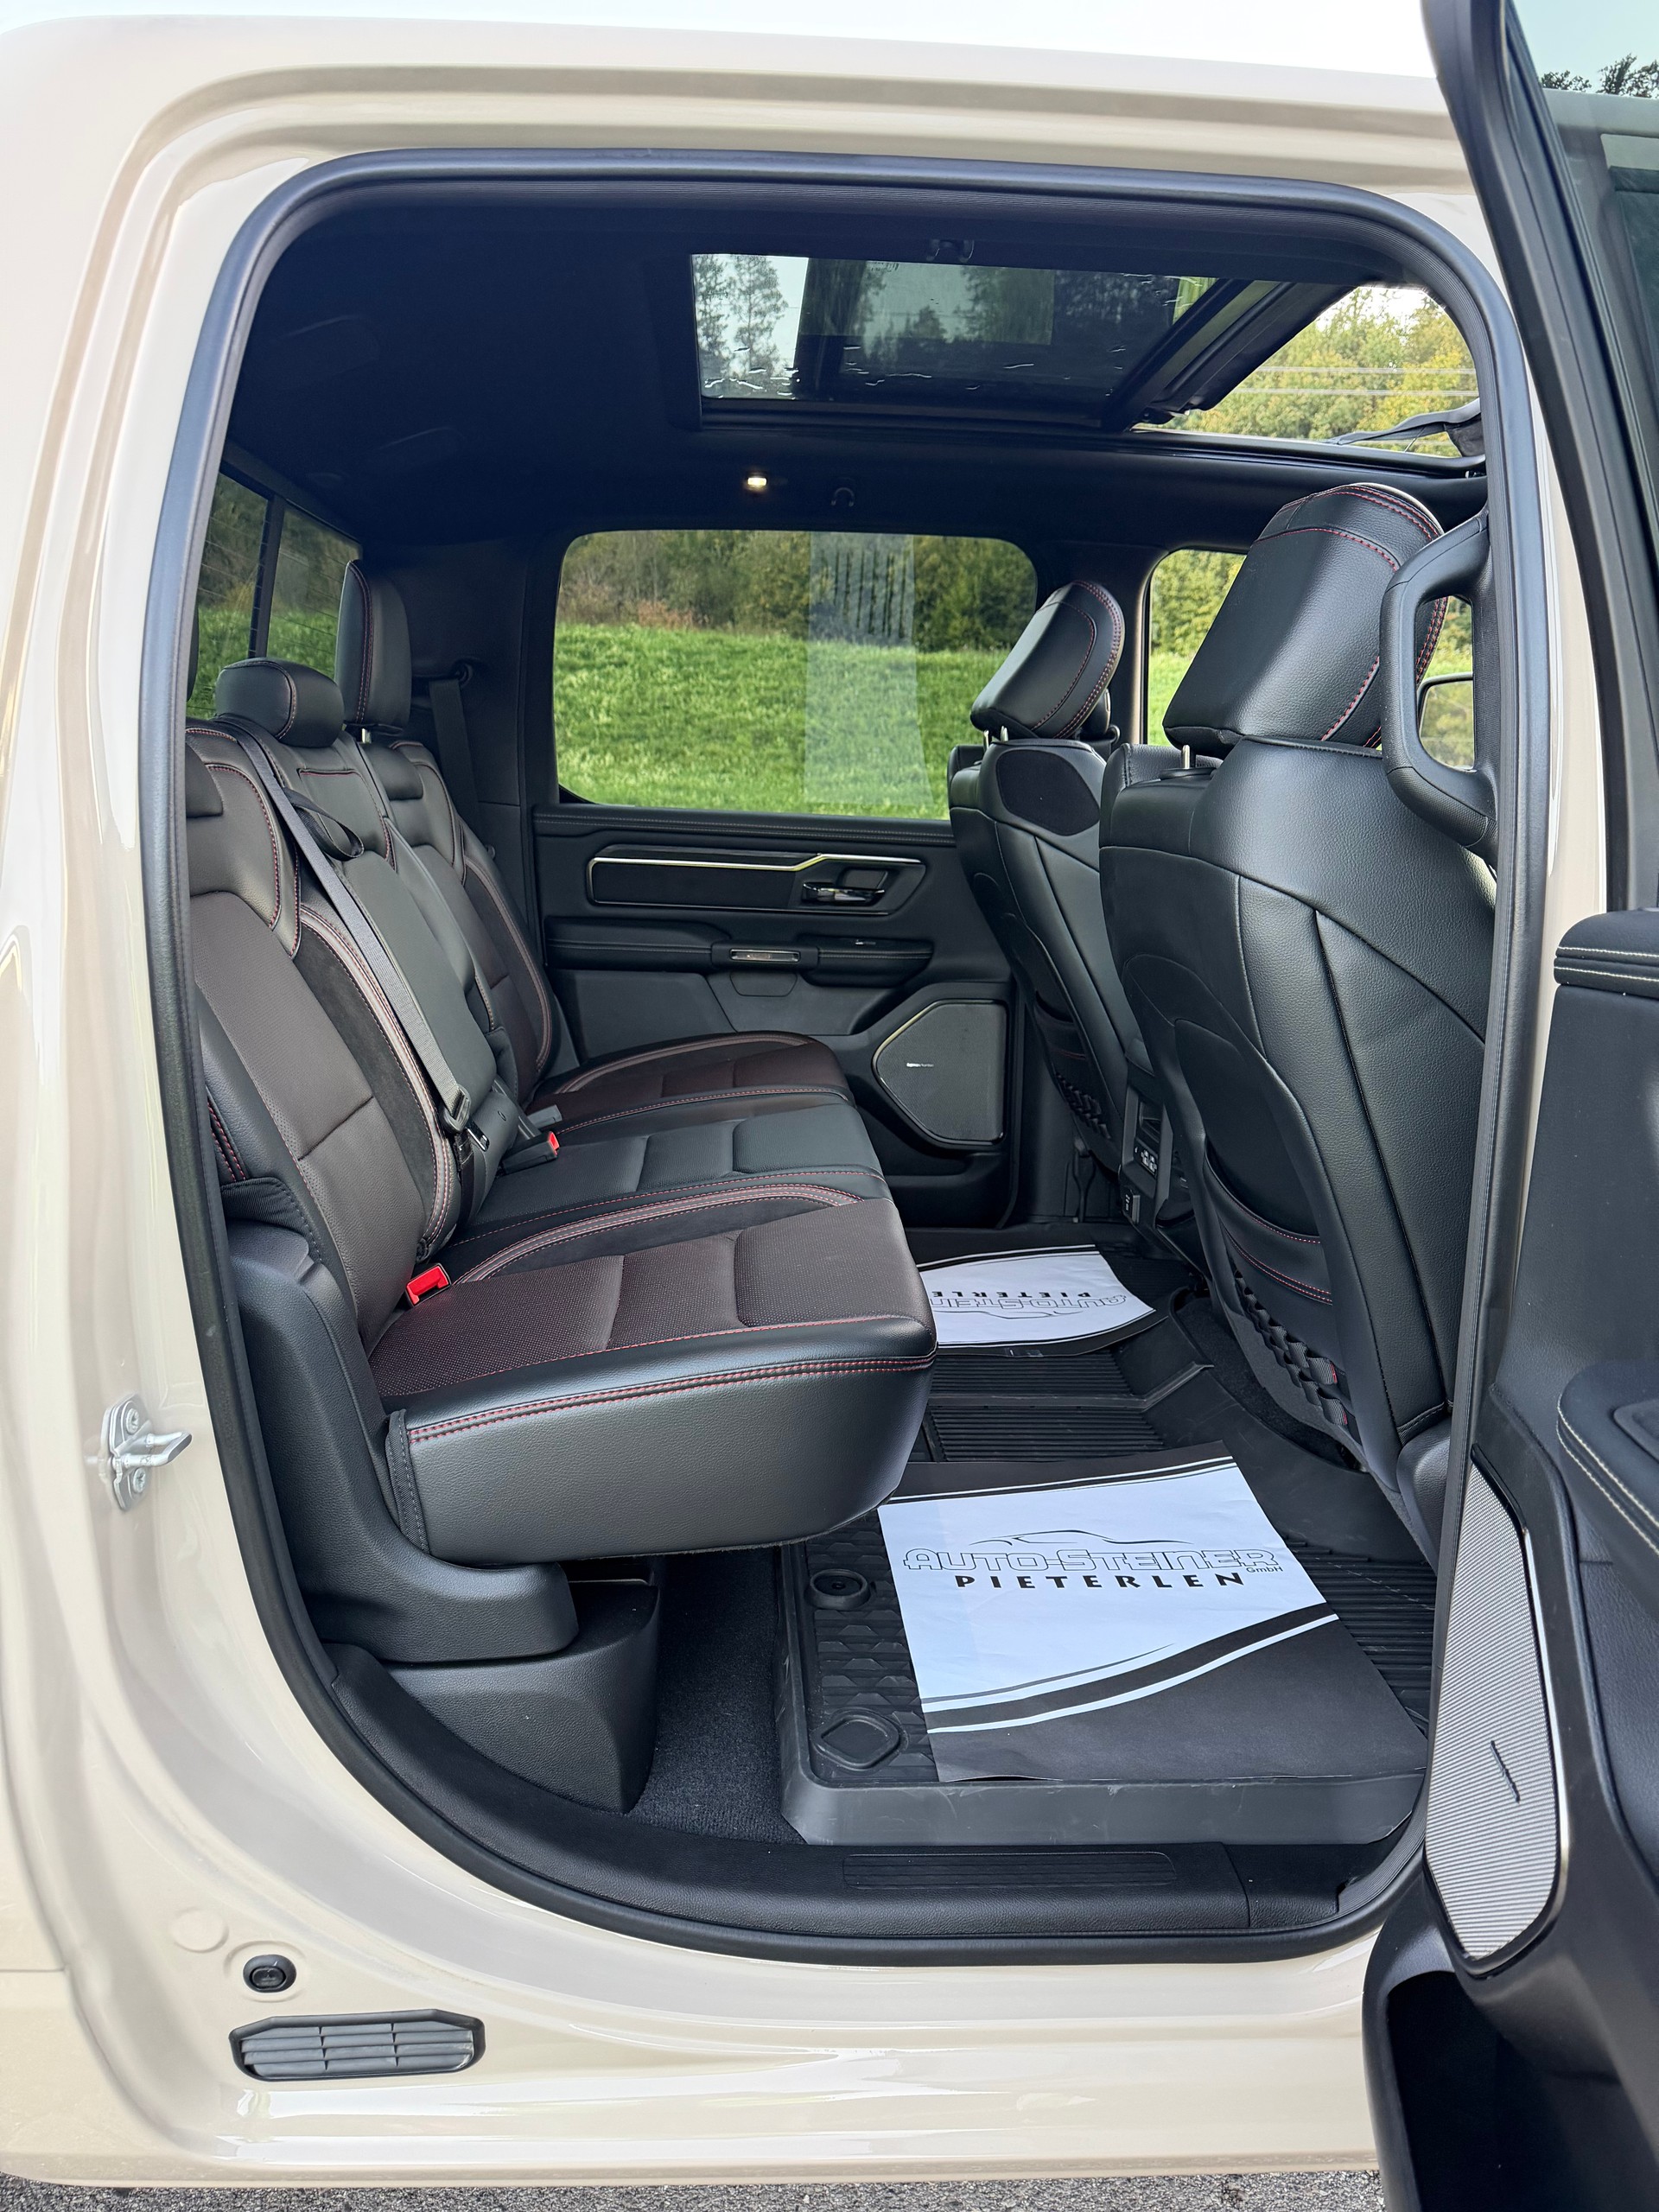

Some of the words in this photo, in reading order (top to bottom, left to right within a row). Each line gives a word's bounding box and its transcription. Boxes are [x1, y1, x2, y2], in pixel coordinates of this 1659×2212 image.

[930, 1294, 1128, 1310] AUTO-STEIN
[903, 1548, 1279, 1571] AUTO-STEINER
[955, 1573, 1244, 1588] PIETERLEN
